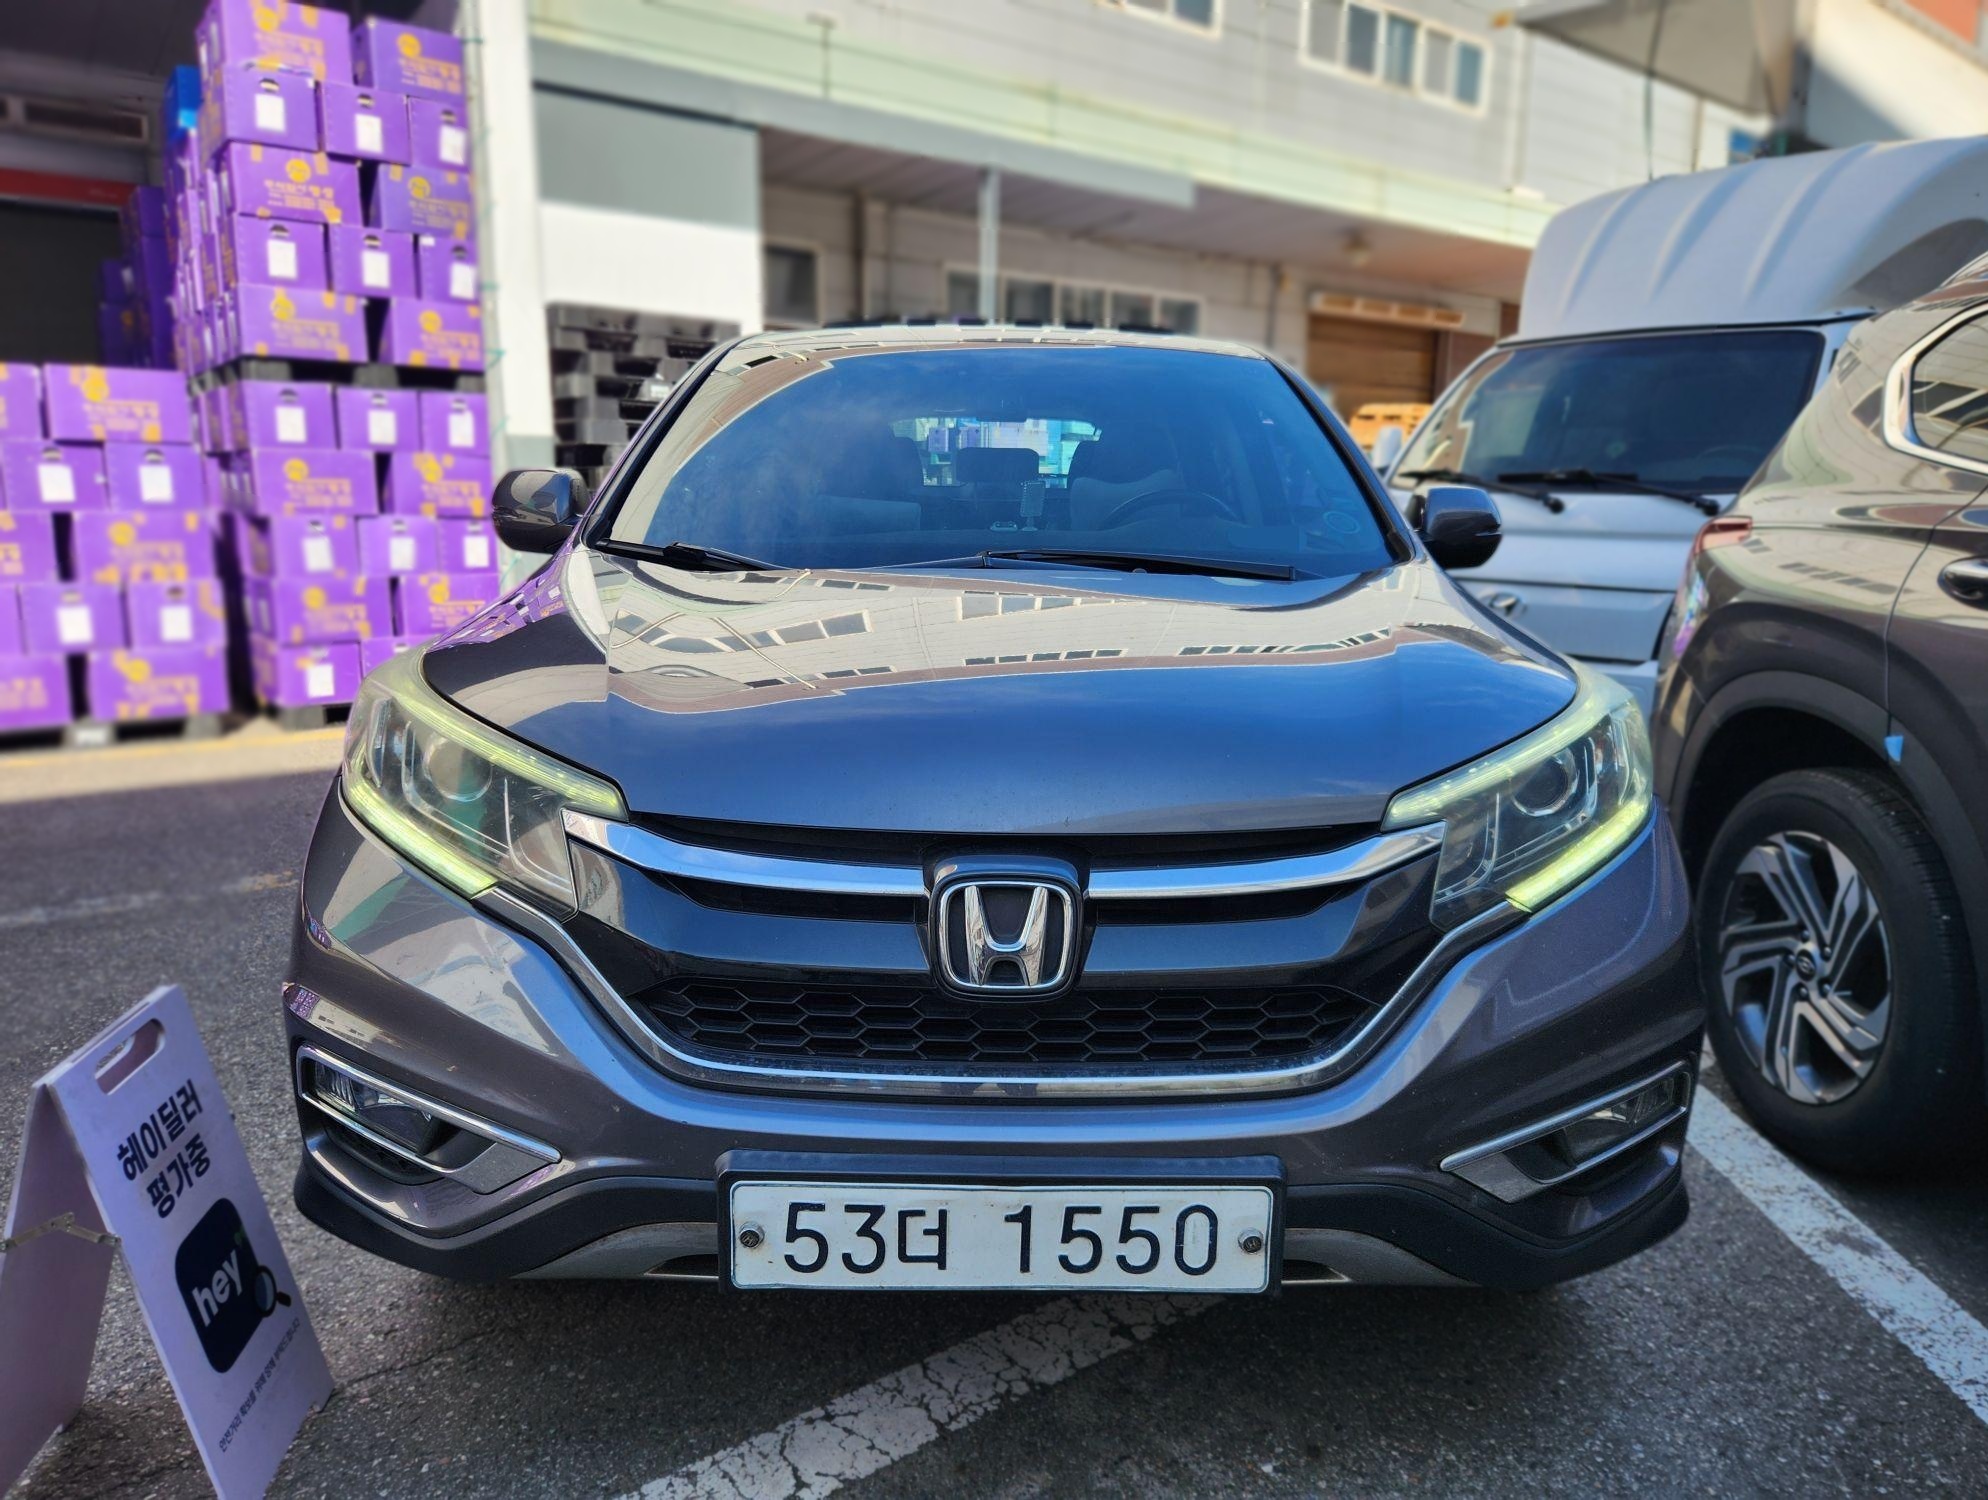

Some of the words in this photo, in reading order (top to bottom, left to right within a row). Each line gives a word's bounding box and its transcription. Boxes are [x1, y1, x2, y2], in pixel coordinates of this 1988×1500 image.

[117, 1078, 203, 1181] 헤이딜러
[147, 1133, 210, 1219] 평가중
[783, 1201, 948, 1273] 53더
[1003, 1204, 1218, 1276] 1550
[192, 1250, 244, 1328] hey
[219, 1413, 242, 1453] 안전거리
